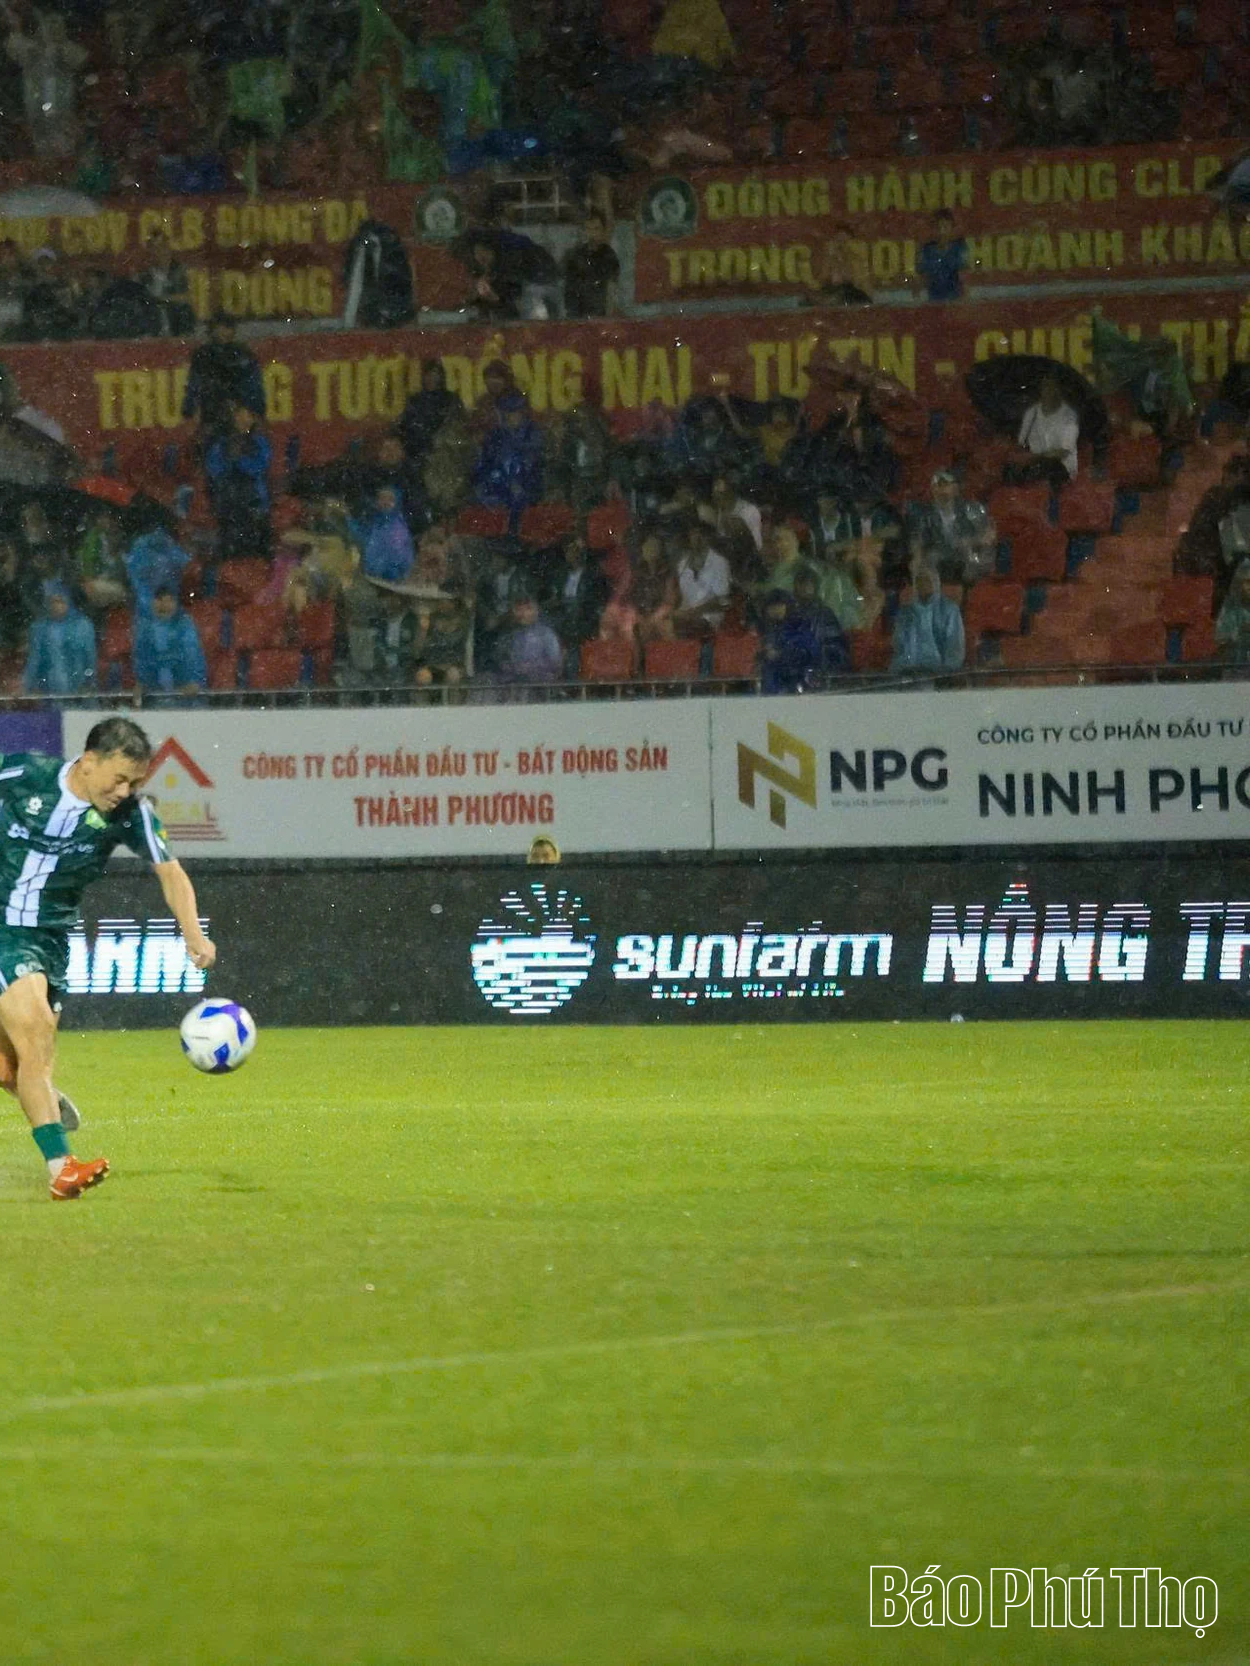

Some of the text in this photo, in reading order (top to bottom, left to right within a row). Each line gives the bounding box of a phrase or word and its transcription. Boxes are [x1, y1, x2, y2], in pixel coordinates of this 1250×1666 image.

[601, 345, 693, 409] NAI
[978, 726, 1034, 744] CÔNG
[1041, 727, 1064, 743] TY
[1104, 718, 1160, 740] PHẦN
[1167, 717, 1211, 739] ĐẦU
[1217, 718, 1244, 736] TƯ
[243, 752, 297, 779] CÔNG
[303, 754, 326, 778] TY
[332, 745, 360, 778] CỔ
[365, 746, 419, 777] PHẦN
[426, 745, 466, 777] ĐẦU
[473, 750, 499, 776] TƯ
[517, 743, 556, 776] BẤT
[562, 744, 619, 778] ĐỘNG
[625, 739, 669, 772] SẢN
[831, 747, 948, 793] NPG
[354, 789, 555, 827] THÀNH PHƯƠNG
[978, 769, 1126, 817] NINH
